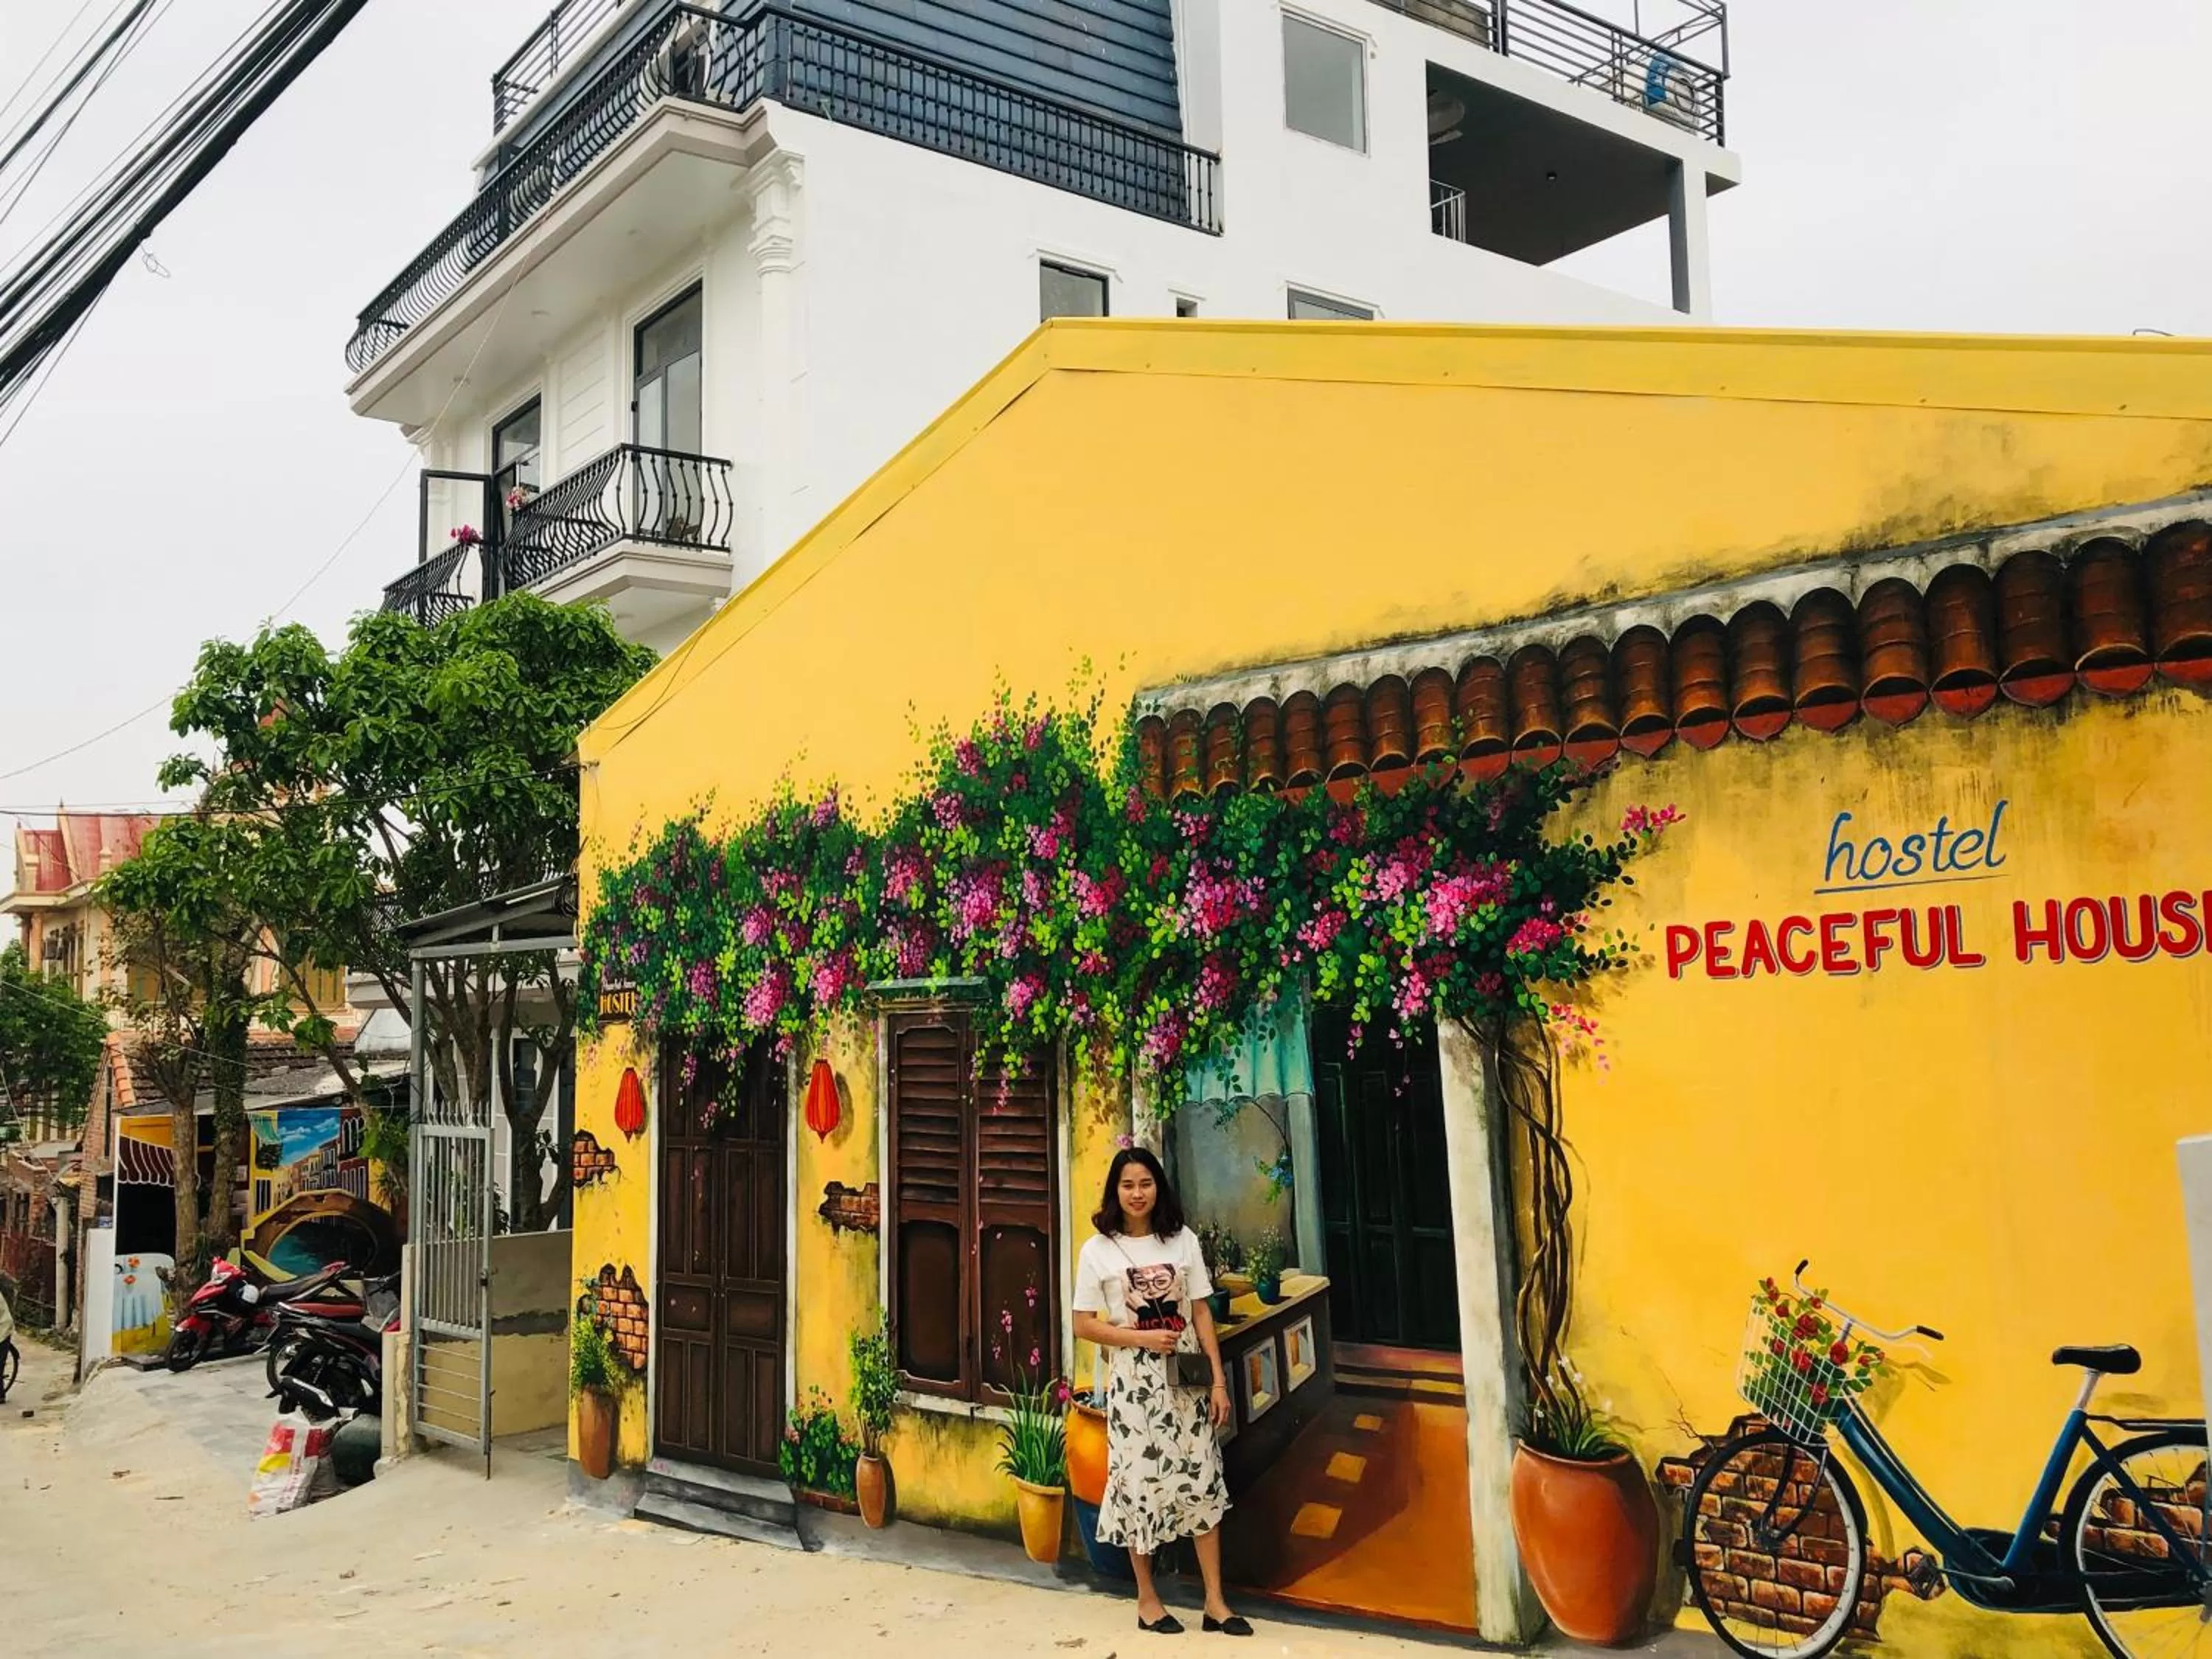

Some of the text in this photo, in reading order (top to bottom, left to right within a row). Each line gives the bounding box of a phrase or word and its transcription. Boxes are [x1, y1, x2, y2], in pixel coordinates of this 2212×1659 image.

[1825, 800, 2007, 882] hostel
[1666, 890, 2212, 979] PEACEFUL HOUS
